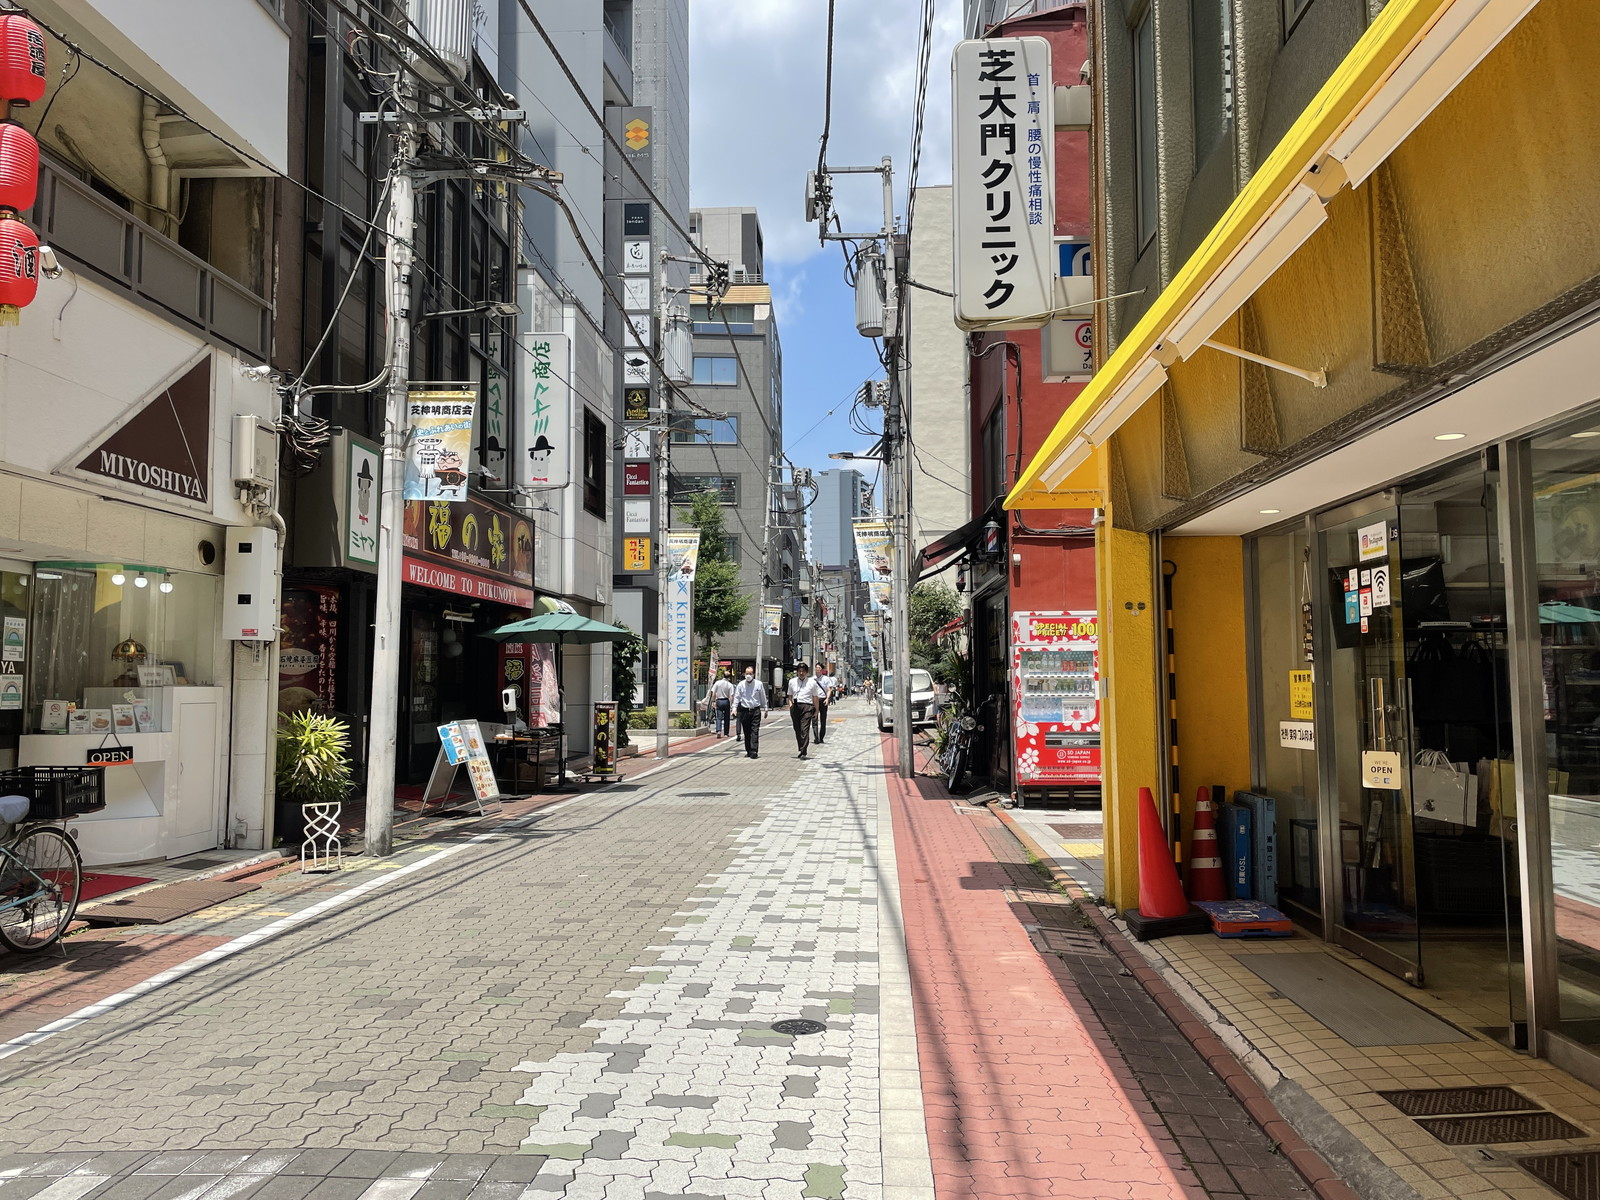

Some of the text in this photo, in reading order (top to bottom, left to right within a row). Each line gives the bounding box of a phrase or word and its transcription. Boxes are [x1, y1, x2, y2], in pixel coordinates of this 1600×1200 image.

[1027, 73, 1042, 225] 首・肩・腰の慢性痛相談
[978, 50, 1019, 310] 芝大門クリニック
[12, 239, 37, 282] 酒
[531, 340, 551, 436] ミヤマ商店
[410, 405, 472, 416] 芝神明商店会
[100, 450, 203, 499] MIYOSHIYA
[351, 530, 375, 552] ミヤマ
[409, 564, 517, 603] WELCOME TO FUKUNOYA
[1034, 622, 1068, 630] SPECIAL
[676, 601, 688, 704] KEIKYU EX INN
[91, 750, 131, 763] OPEN
[1370, 766, 1393, 774] OPEN
